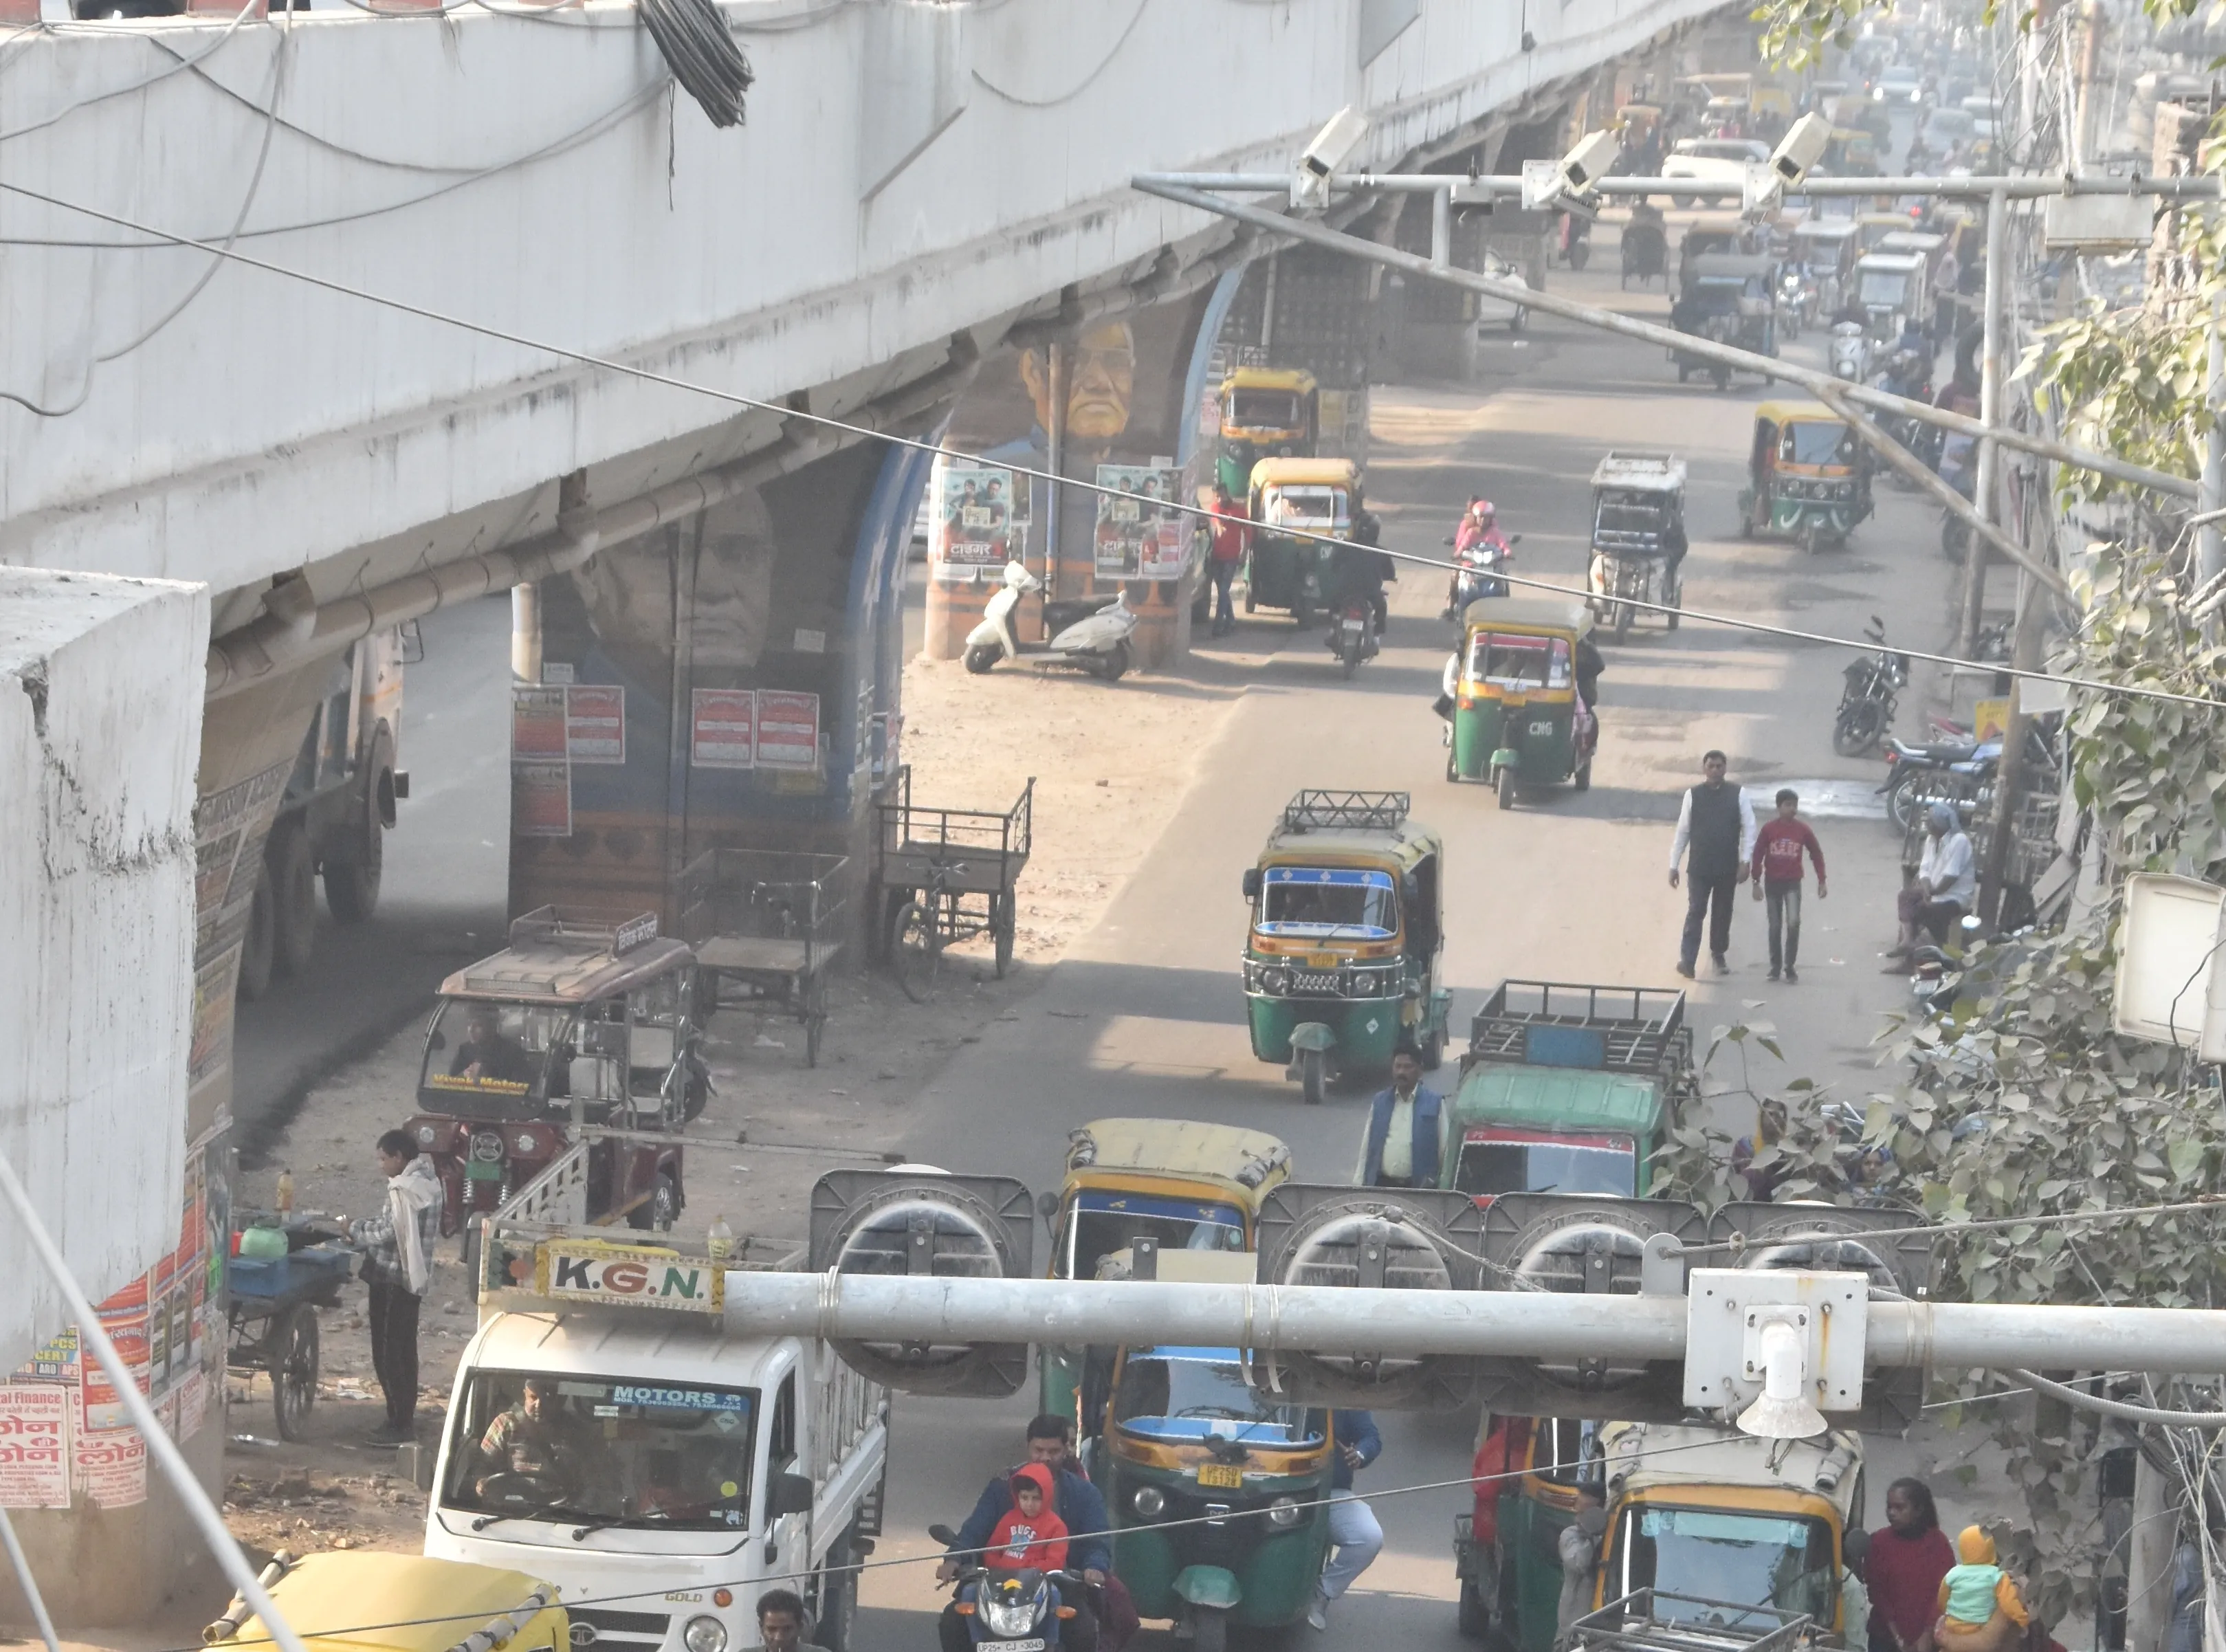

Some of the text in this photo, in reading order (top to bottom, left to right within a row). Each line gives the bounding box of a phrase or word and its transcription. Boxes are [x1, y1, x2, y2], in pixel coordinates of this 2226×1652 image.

[1529, 721, 1553, 736] CNG
[480, 1077, 529, 1089] Motors
[14, 1392, 60, 1403] Finance
[614, 1386, 716, 1404] MOTORS
[1010, 1523, 1037, 1539] BUGS
[665, 1592, 703, 1603] GOLD
